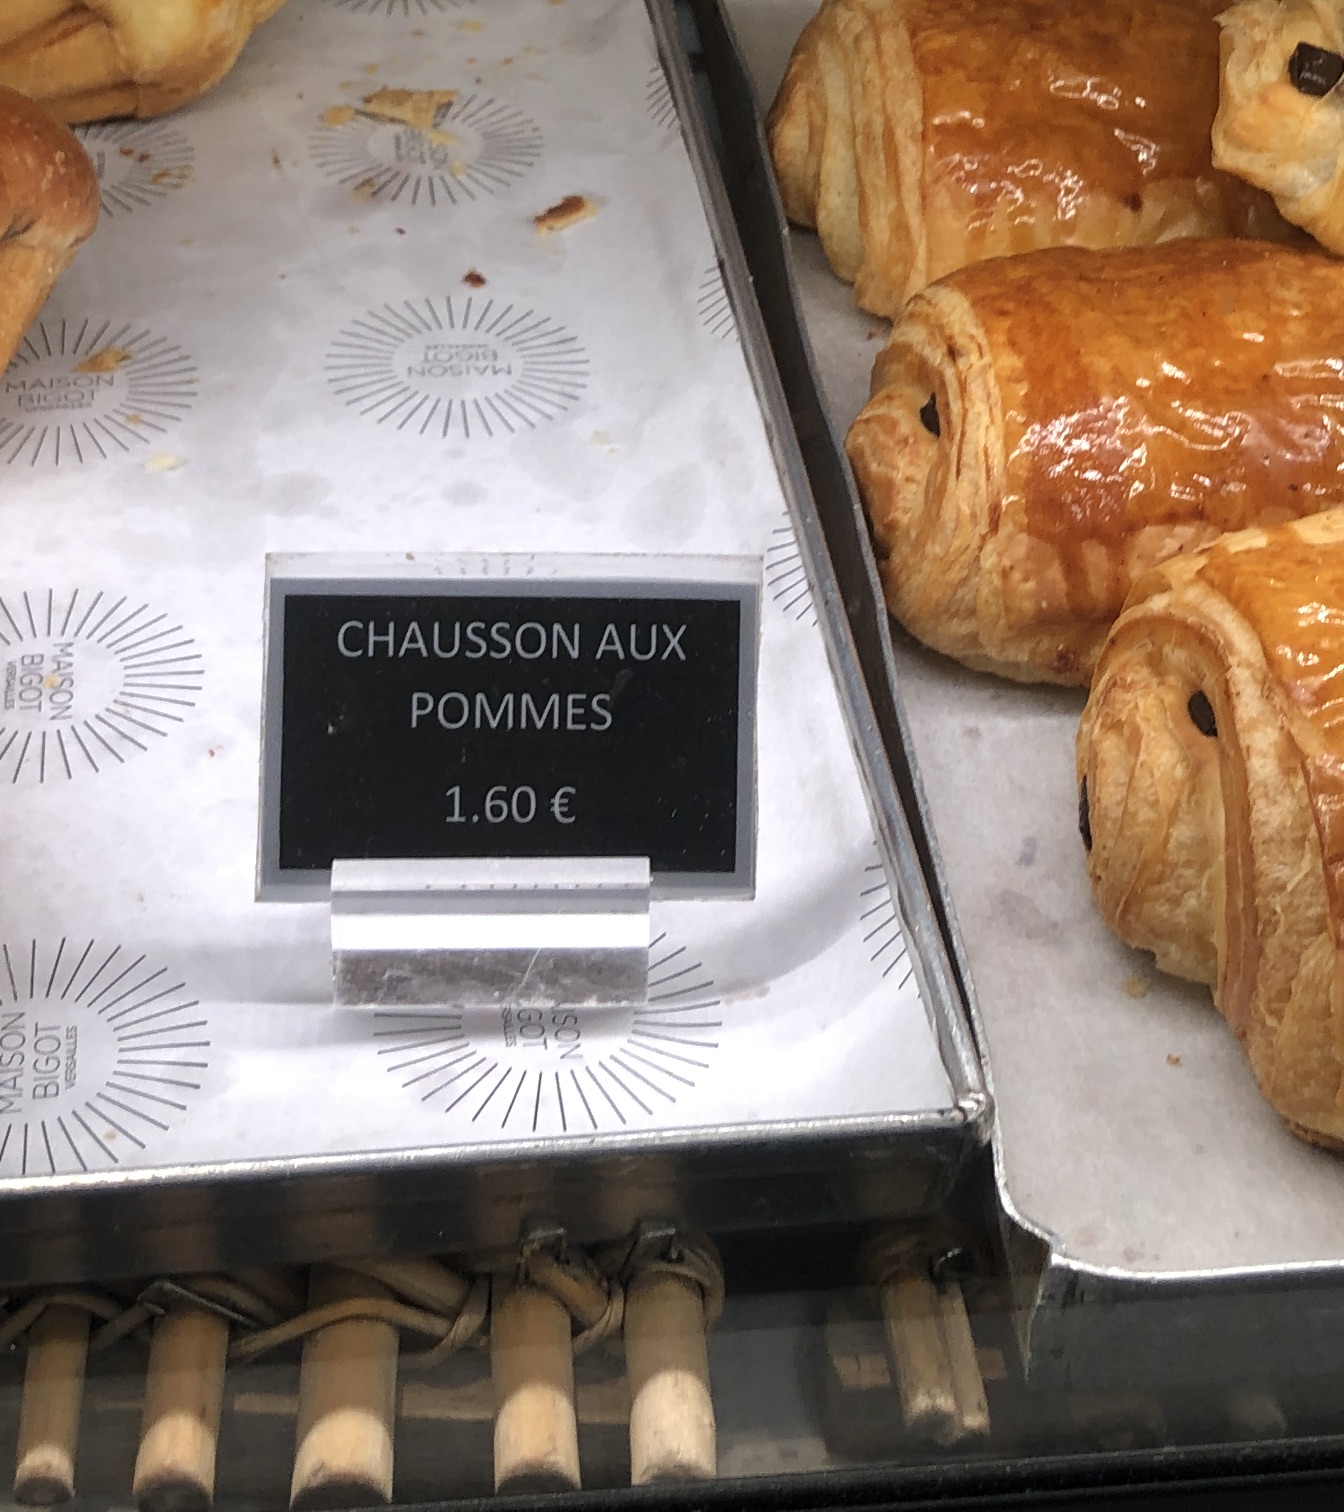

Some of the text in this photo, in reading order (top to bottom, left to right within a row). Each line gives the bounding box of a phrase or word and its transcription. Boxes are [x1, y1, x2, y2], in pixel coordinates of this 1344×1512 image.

[336, 620, 687, 662] CHAUSSON AUX
[18, 653, 44, 713] BIGOT
[49, 642, 74, 721] MAISON
[409, 690, 613, 731] POMMES
[444, 785, 577, 826] 1.60 €
[516, 1008, 548, 1051] GOT
[550, 1002, 583, 1060] ISON
[32, 1022, 61, 1099] BIGOT
